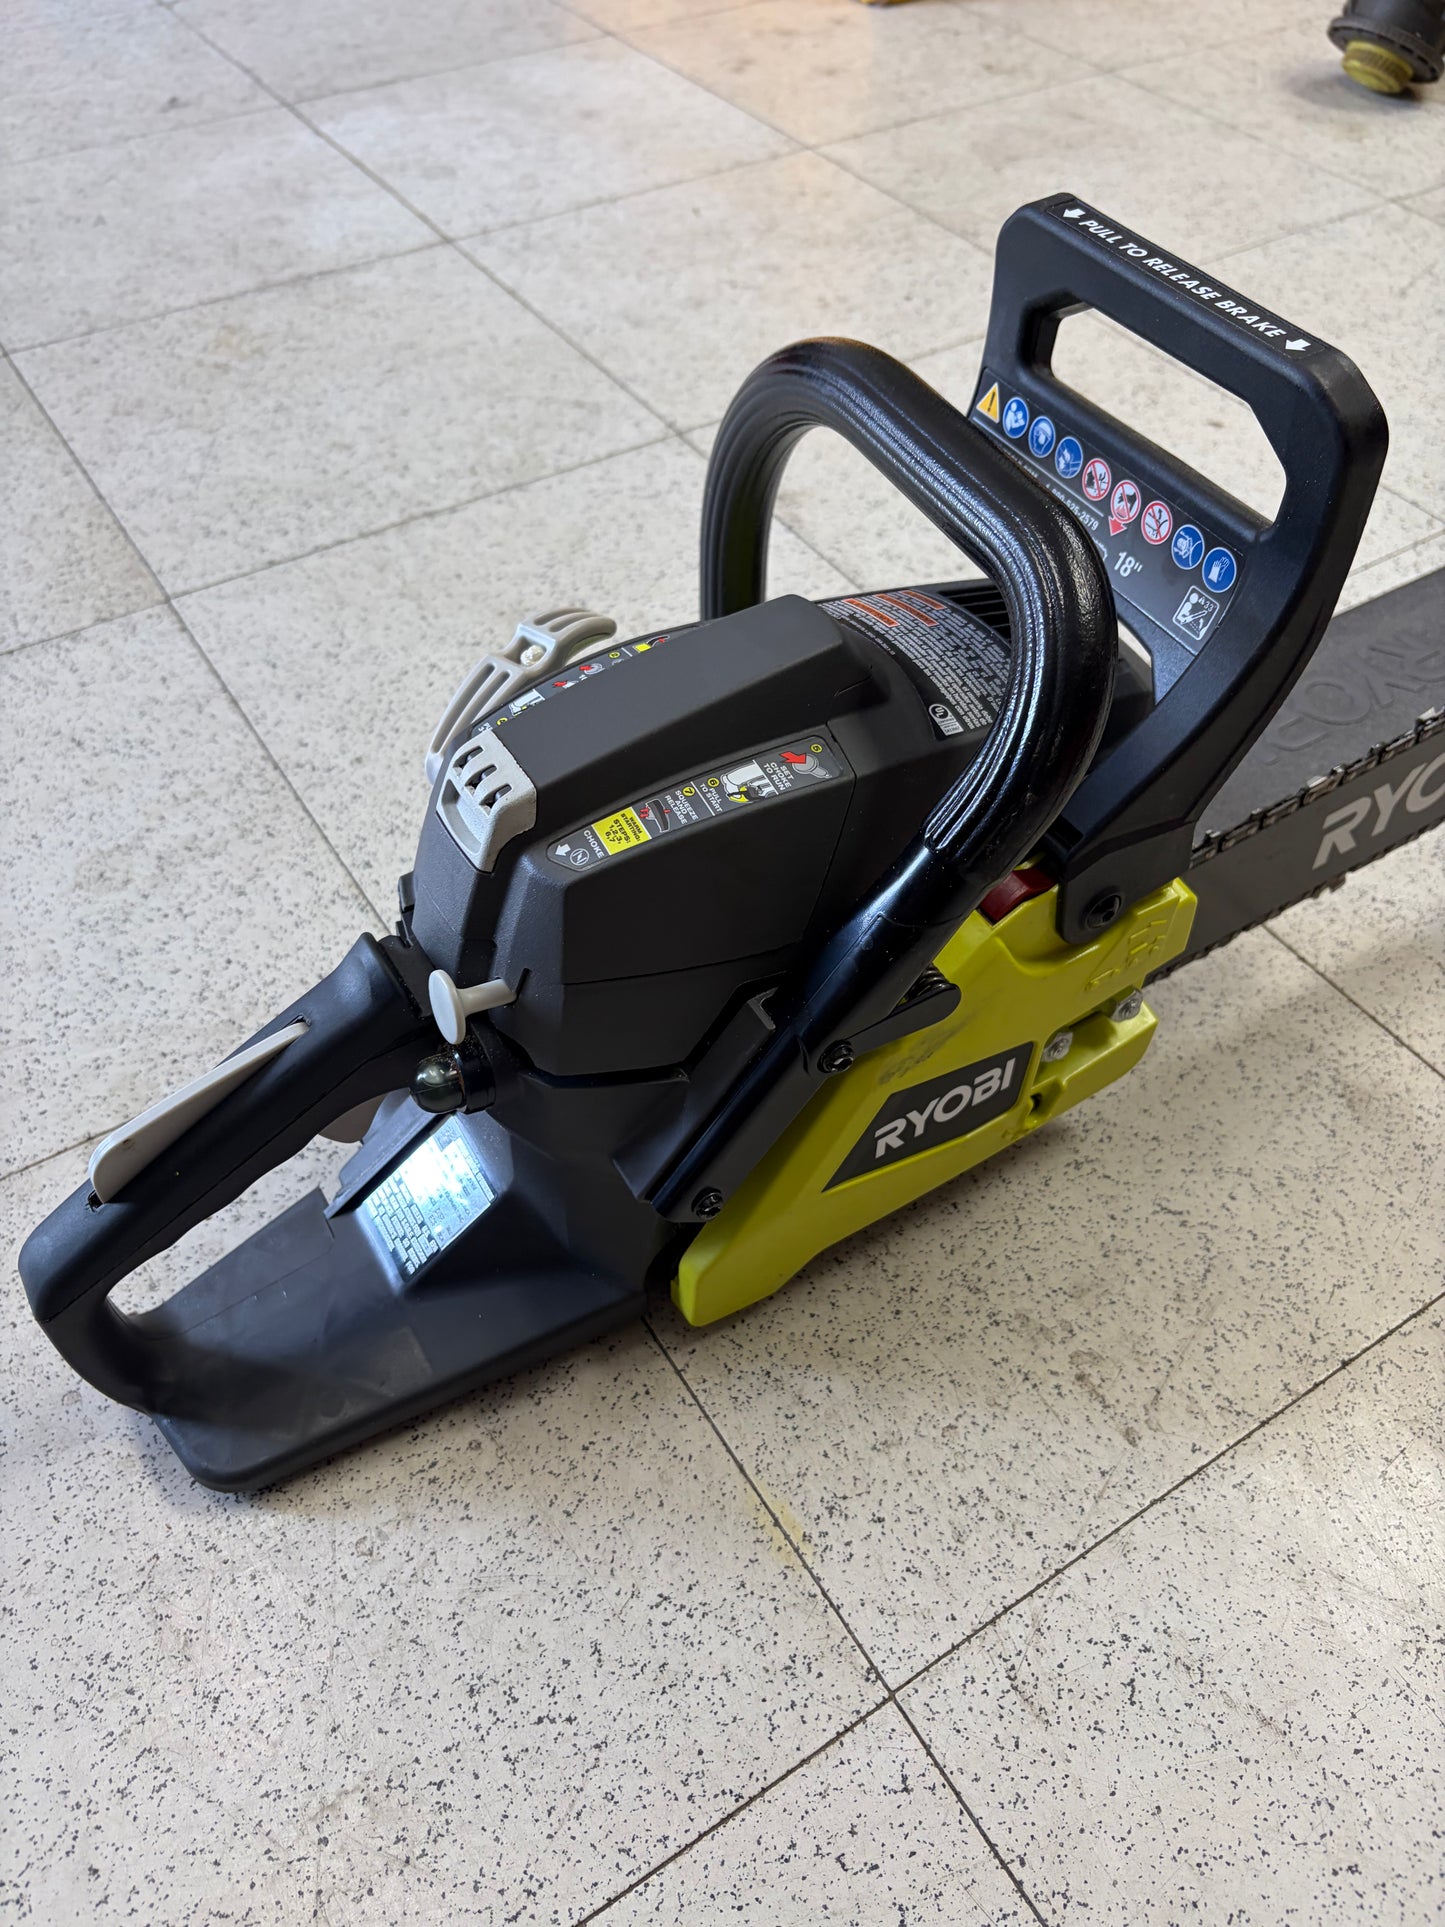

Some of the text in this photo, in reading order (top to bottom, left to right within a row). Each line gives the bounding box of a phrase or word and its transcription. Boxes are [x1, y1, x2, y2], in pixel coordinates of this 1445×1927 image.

[1079, 220, 1286, 338] PULL TO RELEASE BRAKE
[764, 763, 786, 791] TO RUN
[770, 762, 791, 788] CHOKE
[780, 766, 794, 780] SET
[665, 795, 688, 824] RELEASE
[675, 790, 699, 820] SQUEEZE
[675, 800, 687, 814] AND
[700, 784, 722, 812] TO START
[709, 788, 722, 804] PULL
[630, 817, 642, 834] WARM
[584, 830, 604, 858] CHOKE
[874, 1058, 1015, 1158] RYOBI
